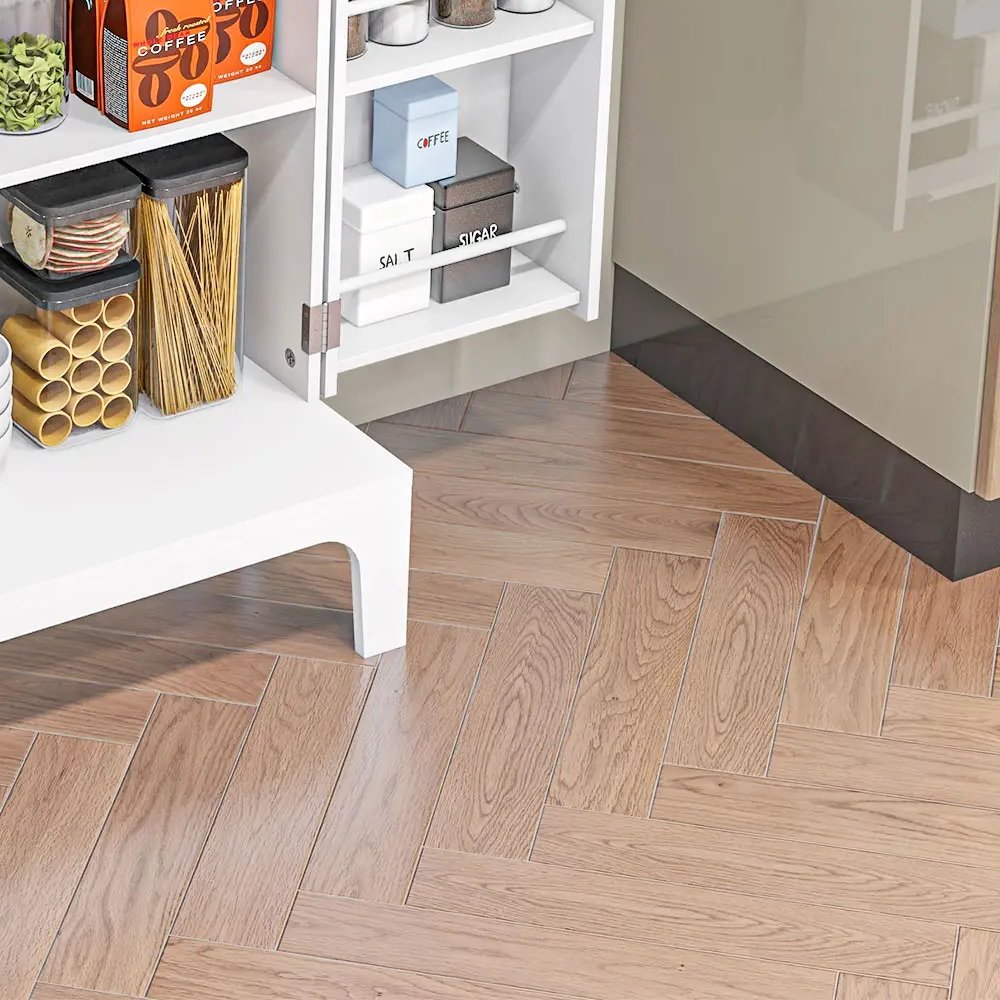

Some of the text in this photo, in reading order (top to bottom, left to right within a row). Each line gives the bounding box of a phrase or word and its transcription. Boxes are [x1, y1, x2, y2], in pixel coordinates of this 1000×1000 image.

[156, 15, 211, 39] fresh roasted
[137, 30, 207, 57] COFFEE
[141, 118, 156, 126] NET
[157, 111, 185, 122] WEIGHT
[416, 130, 450, 149] COFFEE
[458, 223, 499, 248] SUGAR
